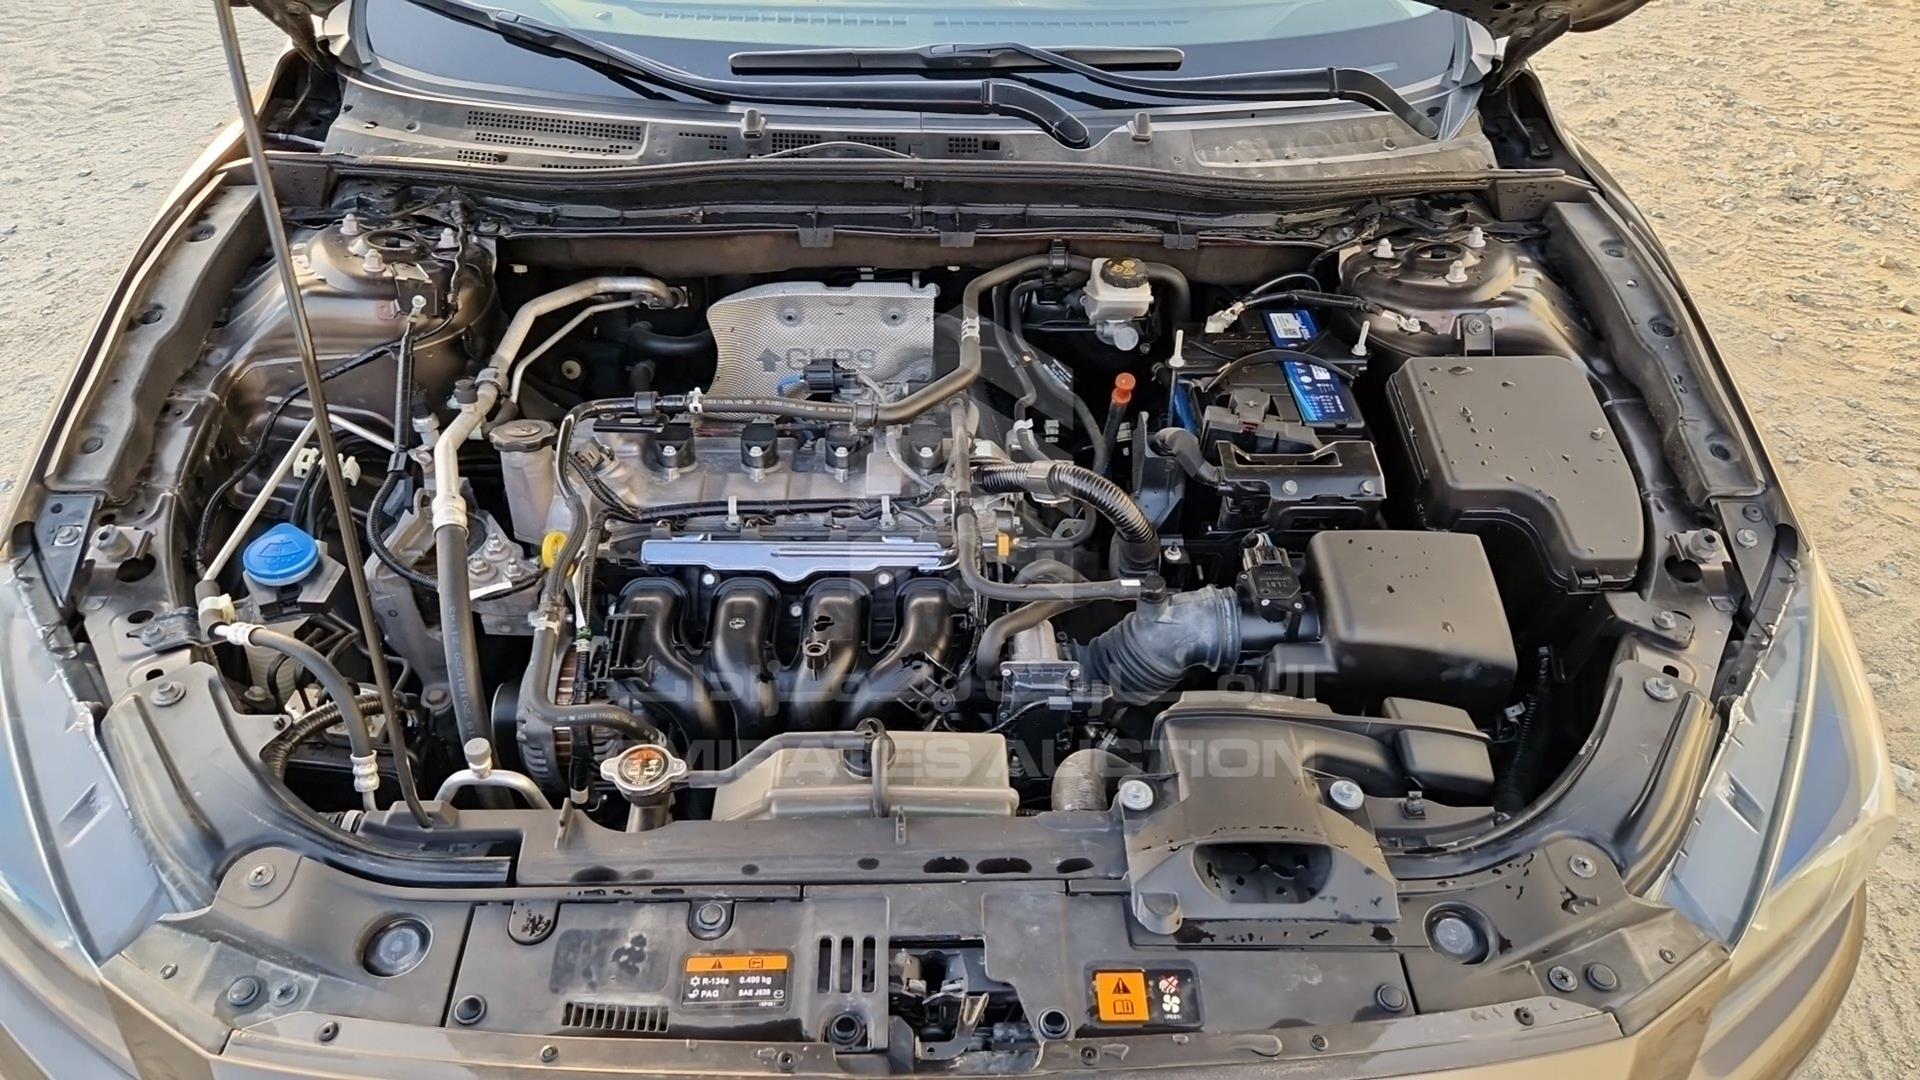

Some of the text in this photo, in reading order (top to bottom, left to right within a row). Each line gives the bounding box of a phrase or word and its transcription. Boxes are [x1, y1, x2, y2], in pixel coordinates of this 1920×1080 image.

[702, 977, 730, 986] R-134a
[761, 976, 772, 985] kg
[700, 989, 720, 998] PAG
[738, 989, 753, 997] SAE
